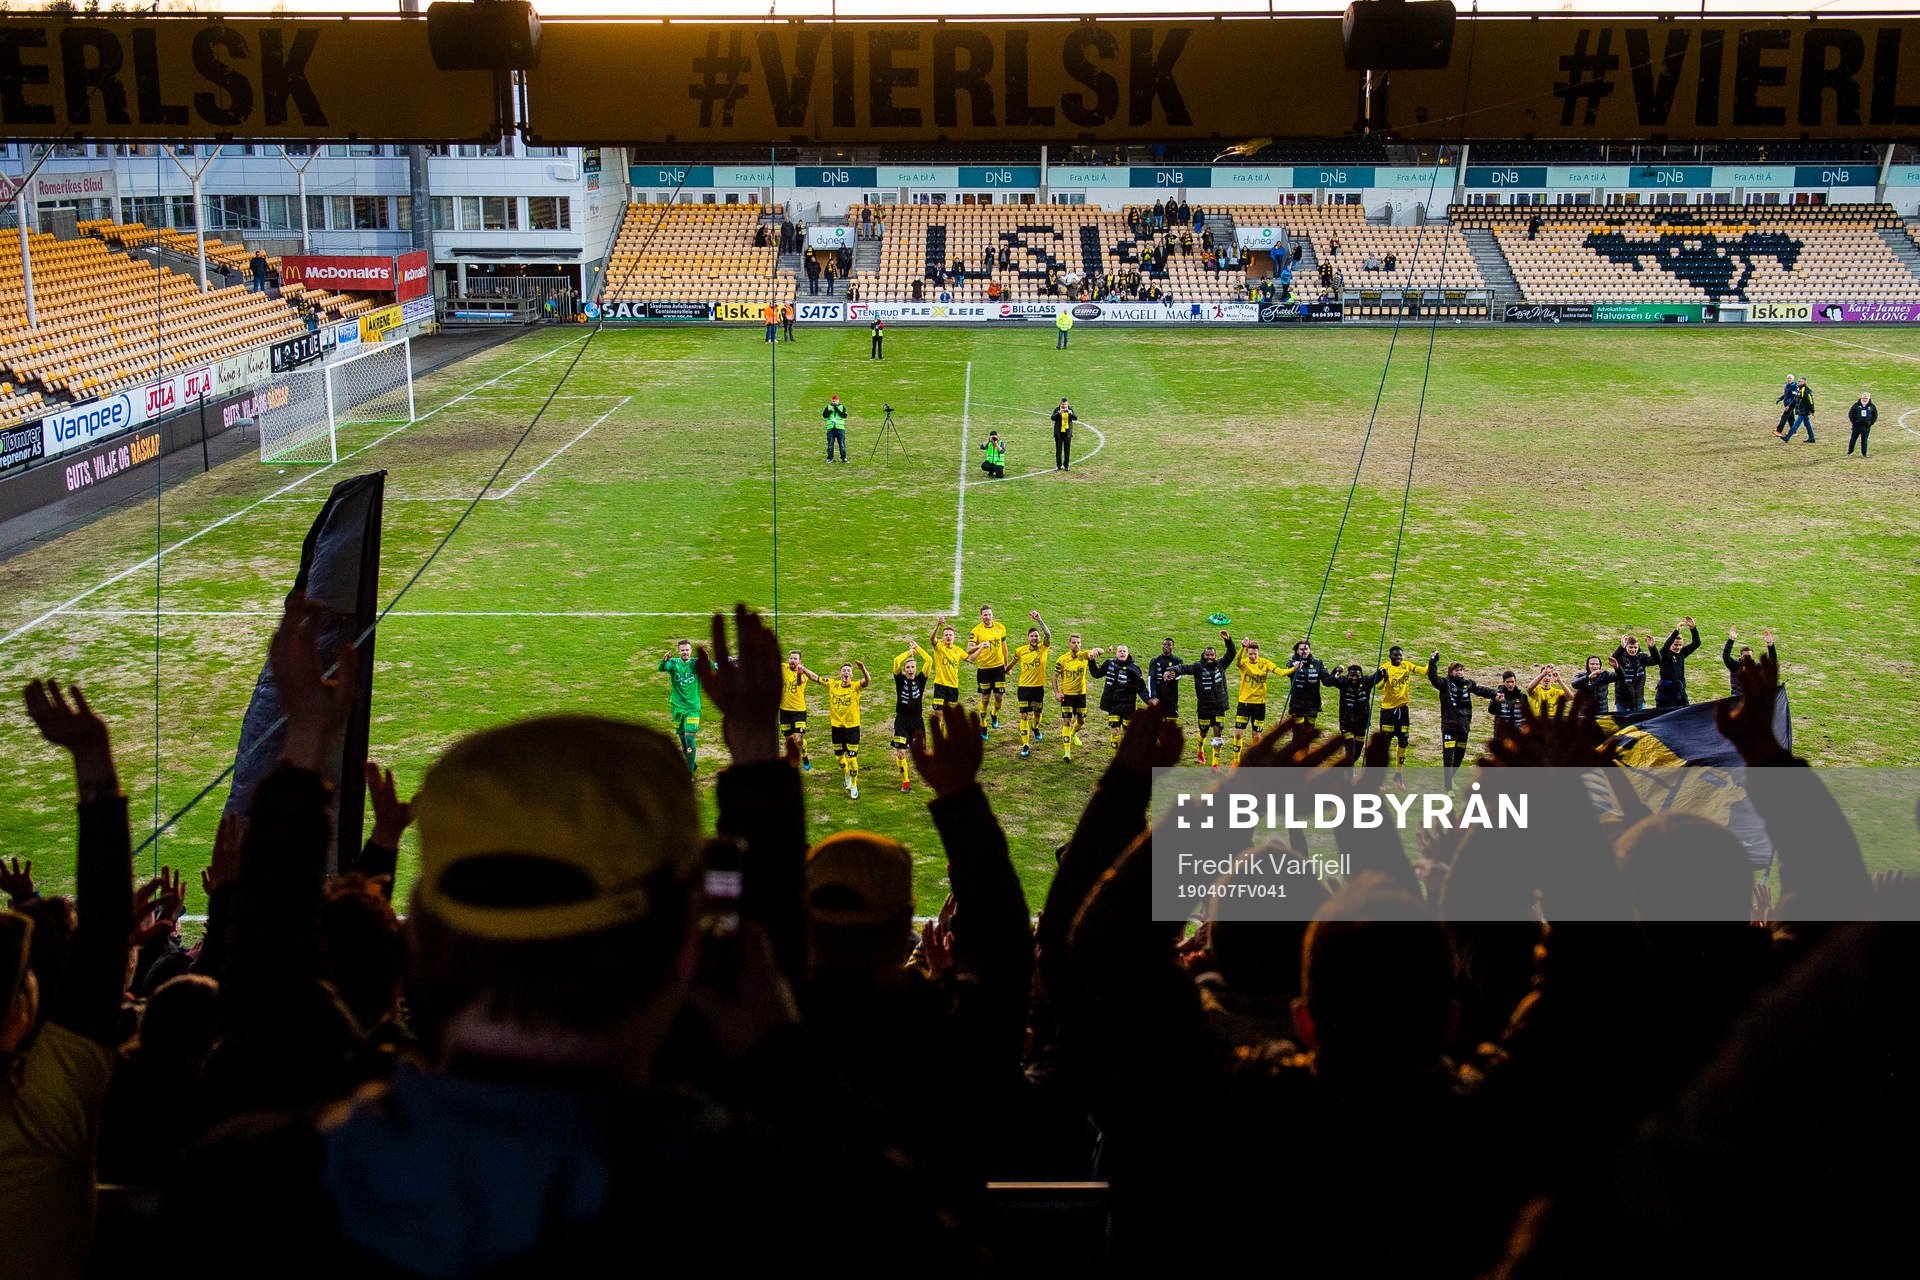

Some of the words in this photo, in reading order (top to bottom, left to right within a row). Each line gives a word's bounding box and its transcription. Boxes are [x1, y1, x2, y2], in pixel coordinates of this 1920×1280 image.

[688, 28, 1194, 128] #VIERLSK
[659, 168, 686, 186] DNB
[735, 173, 748, 181] Fra
[750, 173, 756, 181] A
[757, 172, 765, 181] til
[822, 168, 850, 186] DNB
[899, 173, 911, 182] Fra
[912, 173, 919, 181] A
[920, 173, 929, 181] til
[985, 168, 1013, 187] DNB
[1070, 174, 1083, 182] Fra
[1084, 174, 1091, 182] A
[1092, 173, 1100, 182] til
[1156, 168, 1184, 187] DNB
[1233, 174, 1246, 182] Fra
[1246, 174, 1253, 182] A
[1254, 173, 1263, 182] til
[1320, 168, 1347, 187] DNB
[1397, 174, 1410, 182] Fra
[1411, 174, 1418, 182] A
[1419, 173, 1427, 181] til
[1491, 168, 1519, 187] DNB
[1569, 174, 1582, 182] Fra
[1583, 174, 1590, 182] A
[1591, 173, 1599, 182] til
[1657, 168, 1684, 187] DNB
[1734, 173, 1747, 182] Fra
[1748, 173, 1755, 182] A
[1756, 173, 1764, 182] til
[1822, 168, 1850, 186] DNB
[39, 179, 82, 195] Romerikes
[83, 176, 104, 192] Blad
[1242, 235, 1272, 248] dynea
[305, 266, 390, 279] McDonald's
[404, 265, 428, 282] McDonald's
[601, 302, 646, 318] SAC
[800, 305, 840, 319] SATS
[850, 303, 899, 320] STENERUD
[901, 305, 985, 318] FLEXLEIE
[1012, 305, 1056, 314] BILGLASS
[1596, 311, 1642, 320] Halvorsen
[1645, 312, 1651, 320] &
[1752, 304, 1808, 319] lsk.no
[1859, 312, 1909, 321] SALONG
[185, 373, 211, 398] JUA
[147, 381, 175, 411] JULA
[52, 401, 124, 443] Vanpee
[65, 460, 94, 491] GUTS,
[92, 450, 119, 480] VILJE
[118, 445, 131, 470] OG
